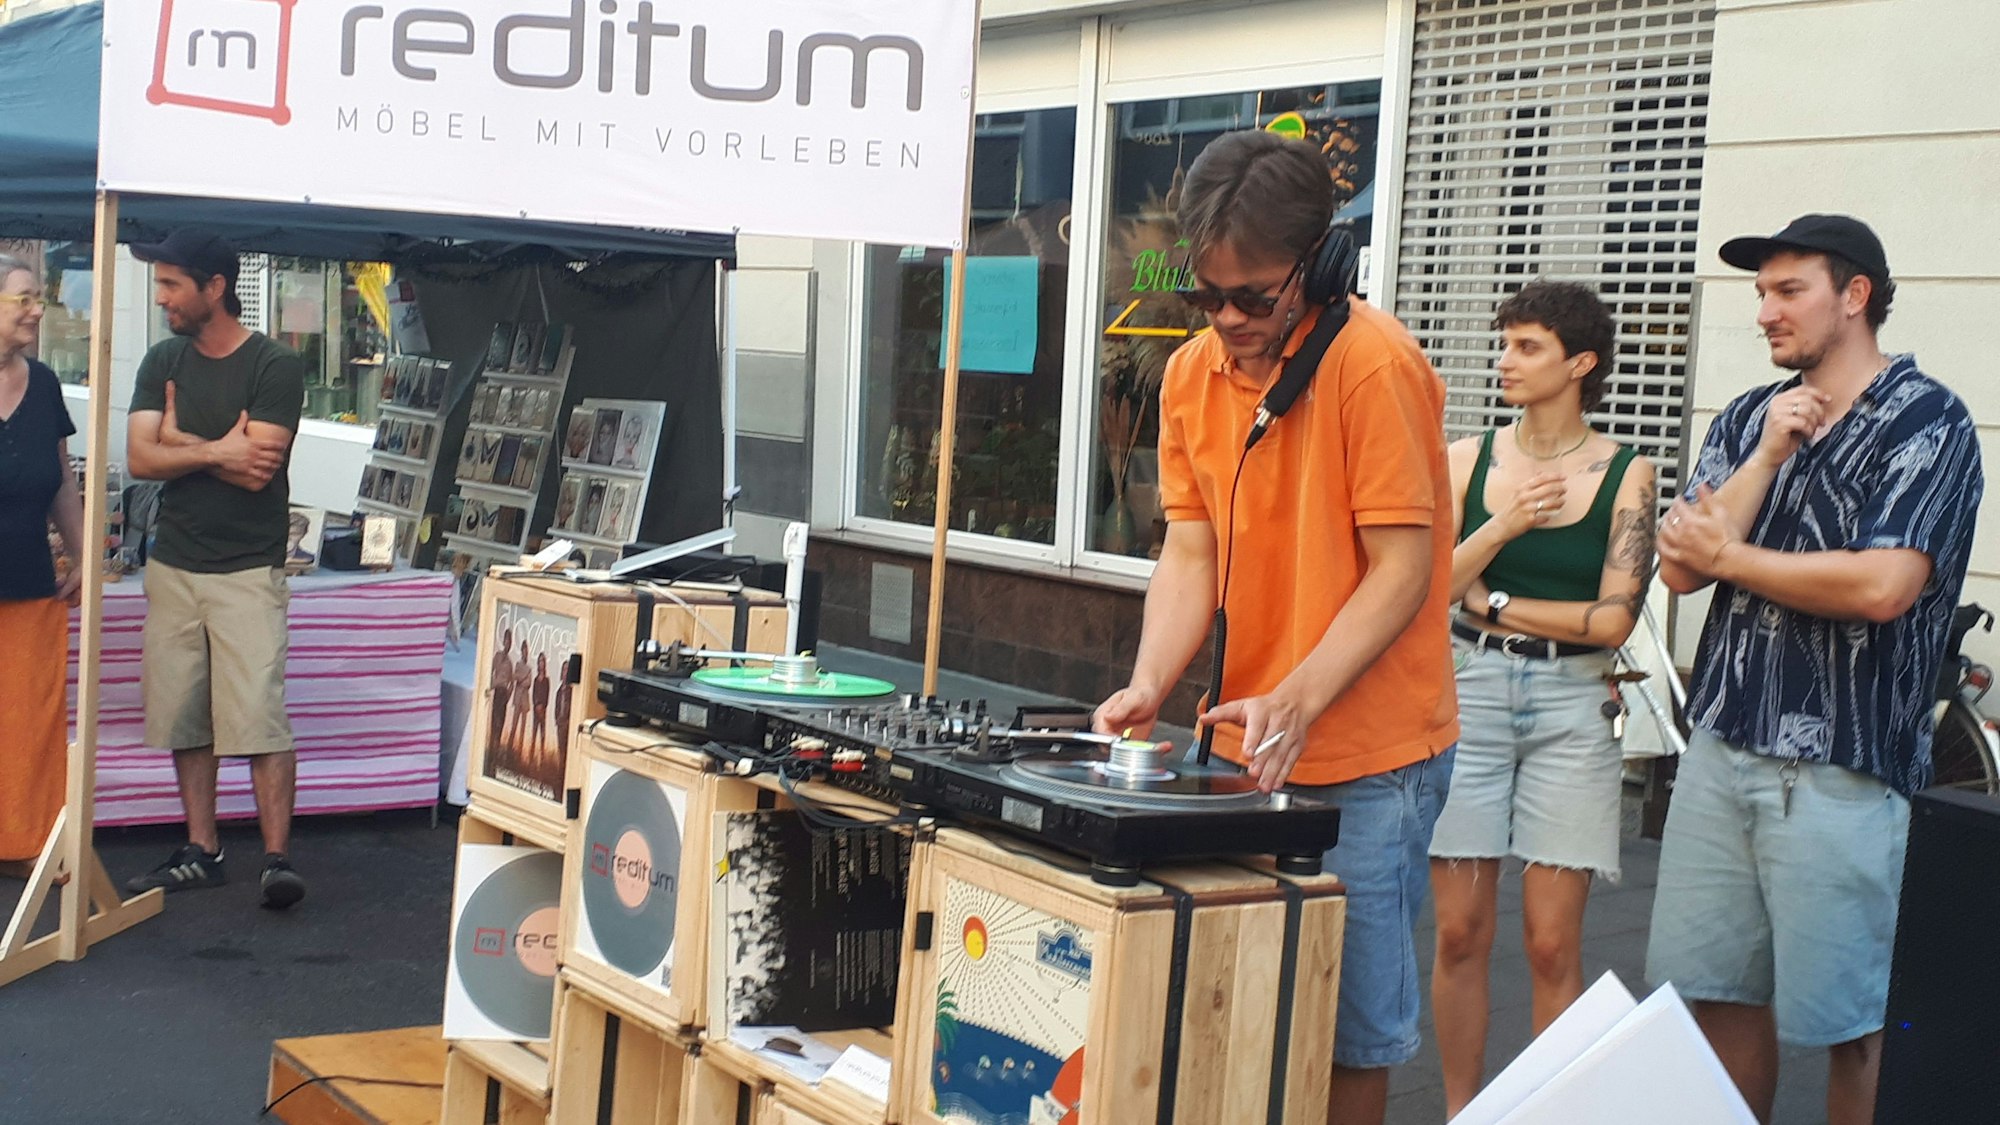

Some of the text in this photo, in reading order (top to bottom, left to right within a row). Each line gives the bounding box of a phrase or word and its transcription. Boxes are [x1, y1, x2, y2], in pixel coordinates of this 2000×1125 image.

[340, 0, 924, 111] reditum
[337, 103, 920, 169] MÖBEL MIT VORLEBEN
[611, 855, 675, 893] reditum
